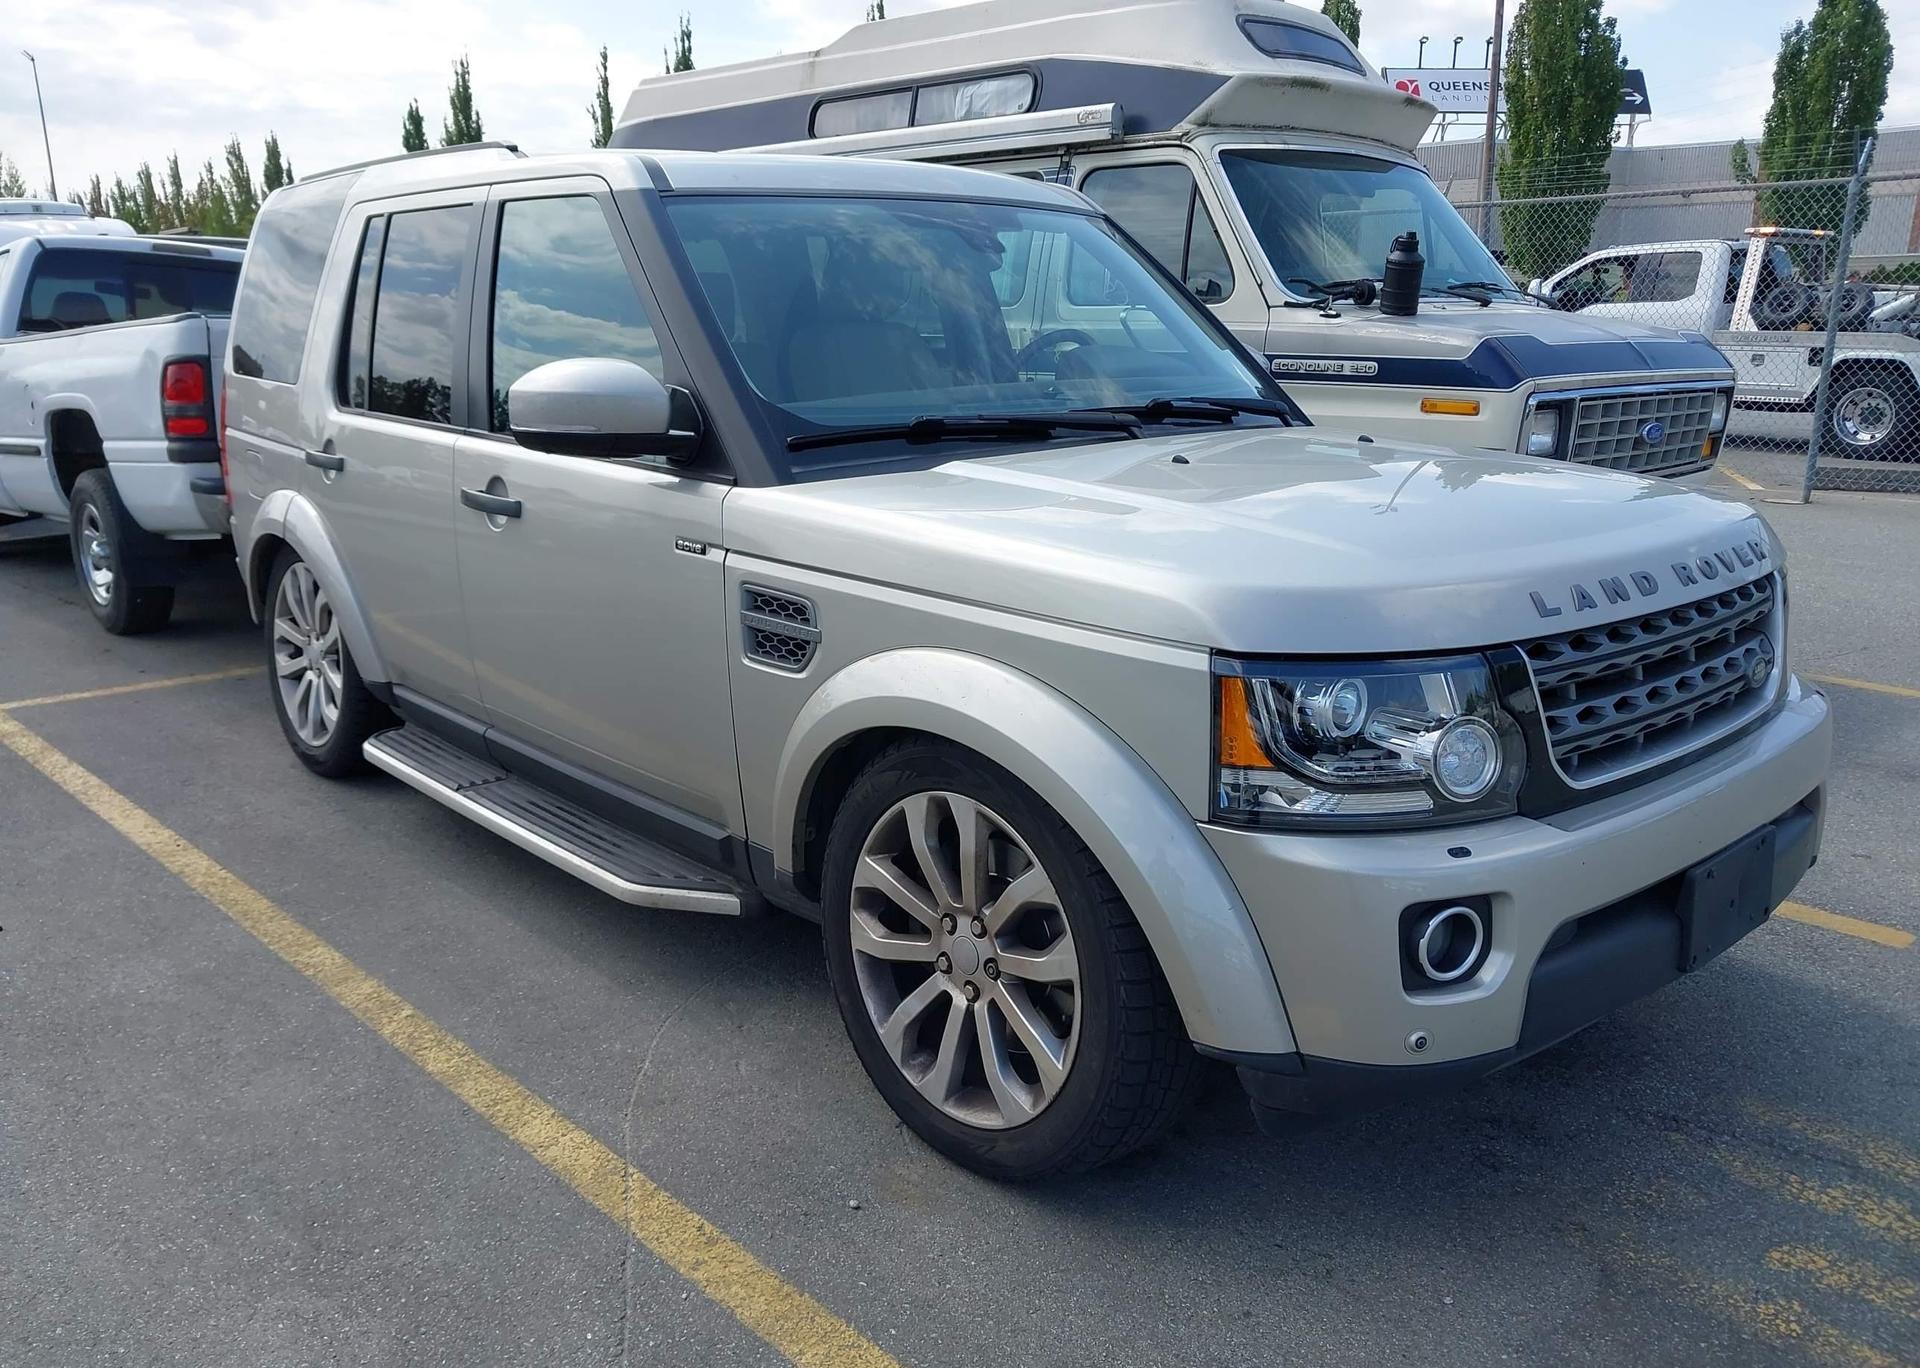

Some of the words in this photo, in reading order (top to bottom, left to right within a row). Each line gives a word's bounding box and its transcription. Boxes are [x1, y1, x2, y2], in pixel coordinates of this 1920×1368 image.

[1273, 361, 1343, 372] ECONOLINE
[1349, 363, 1376, 374] 250
[1529, 570, 1659, 618] LAND
[1671, 539, 1768, 587] ROVER
